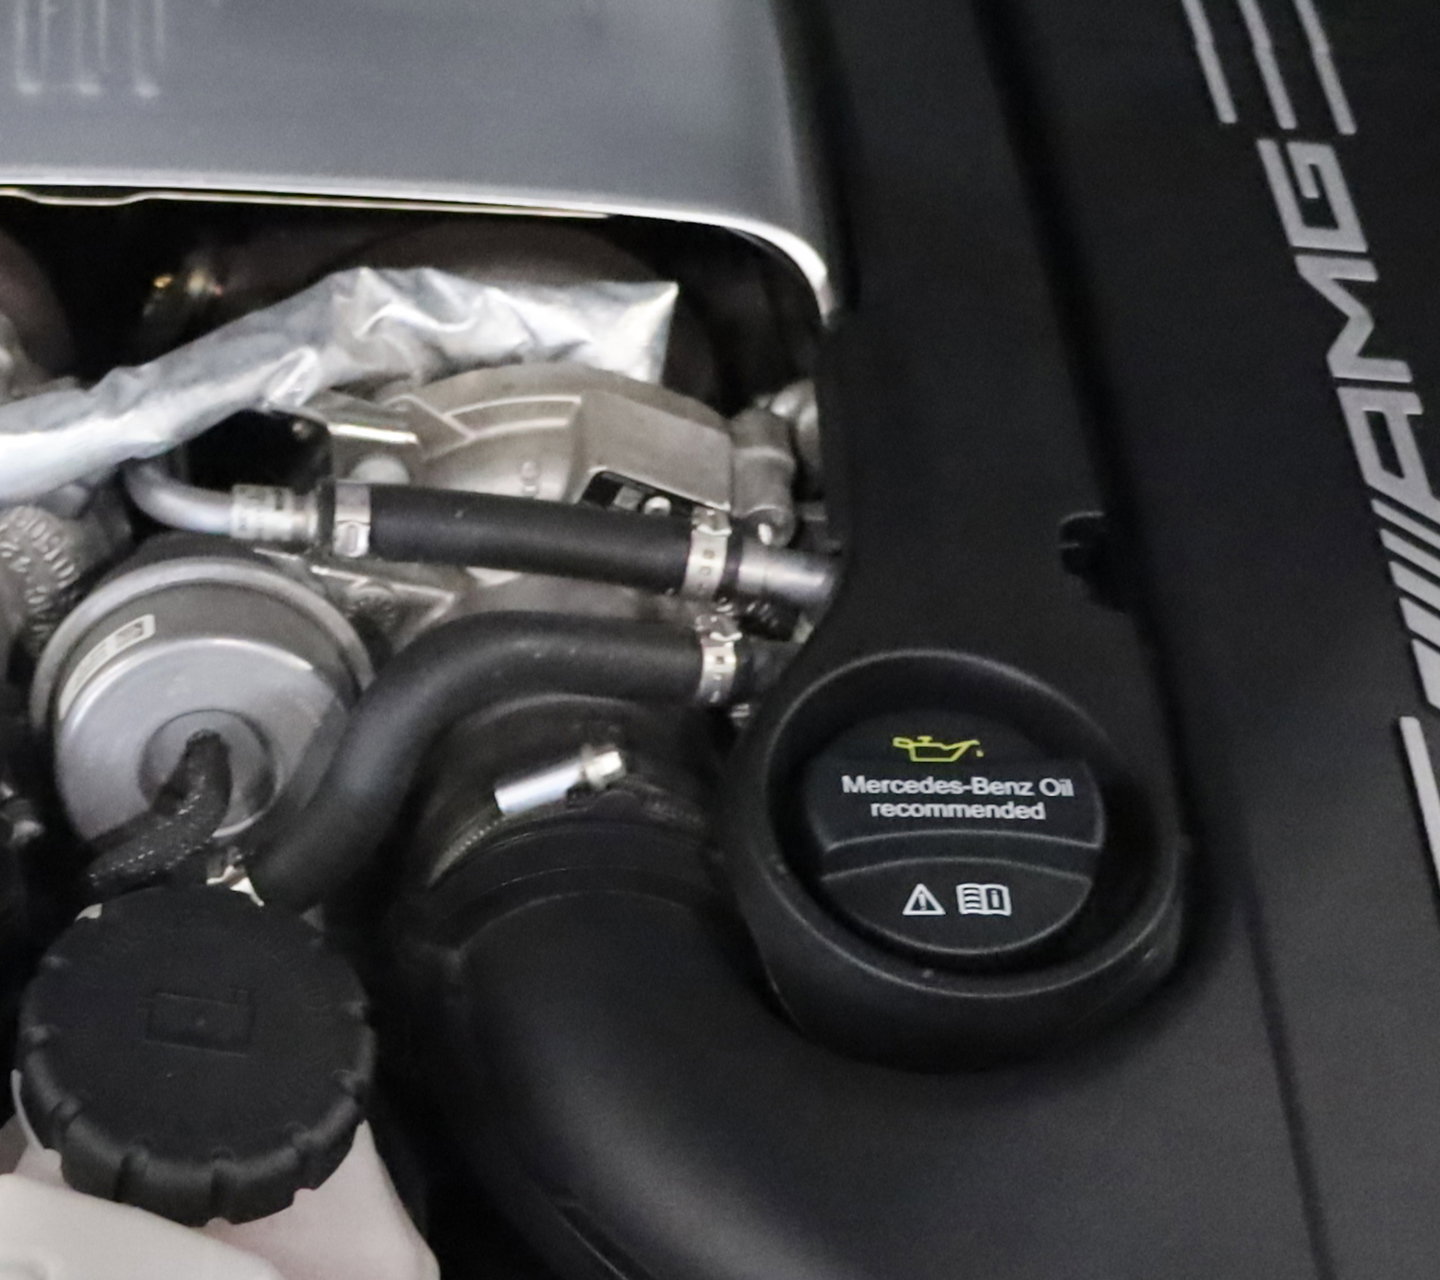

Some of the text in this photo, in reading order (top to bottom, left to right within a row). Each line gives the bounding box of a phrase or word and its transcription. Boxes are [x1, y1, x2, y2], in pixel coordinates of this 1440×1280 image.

[841, 775, 1075, 797] Mercedes-Benz Oil
[870, 801, 1046, 820] recommended
